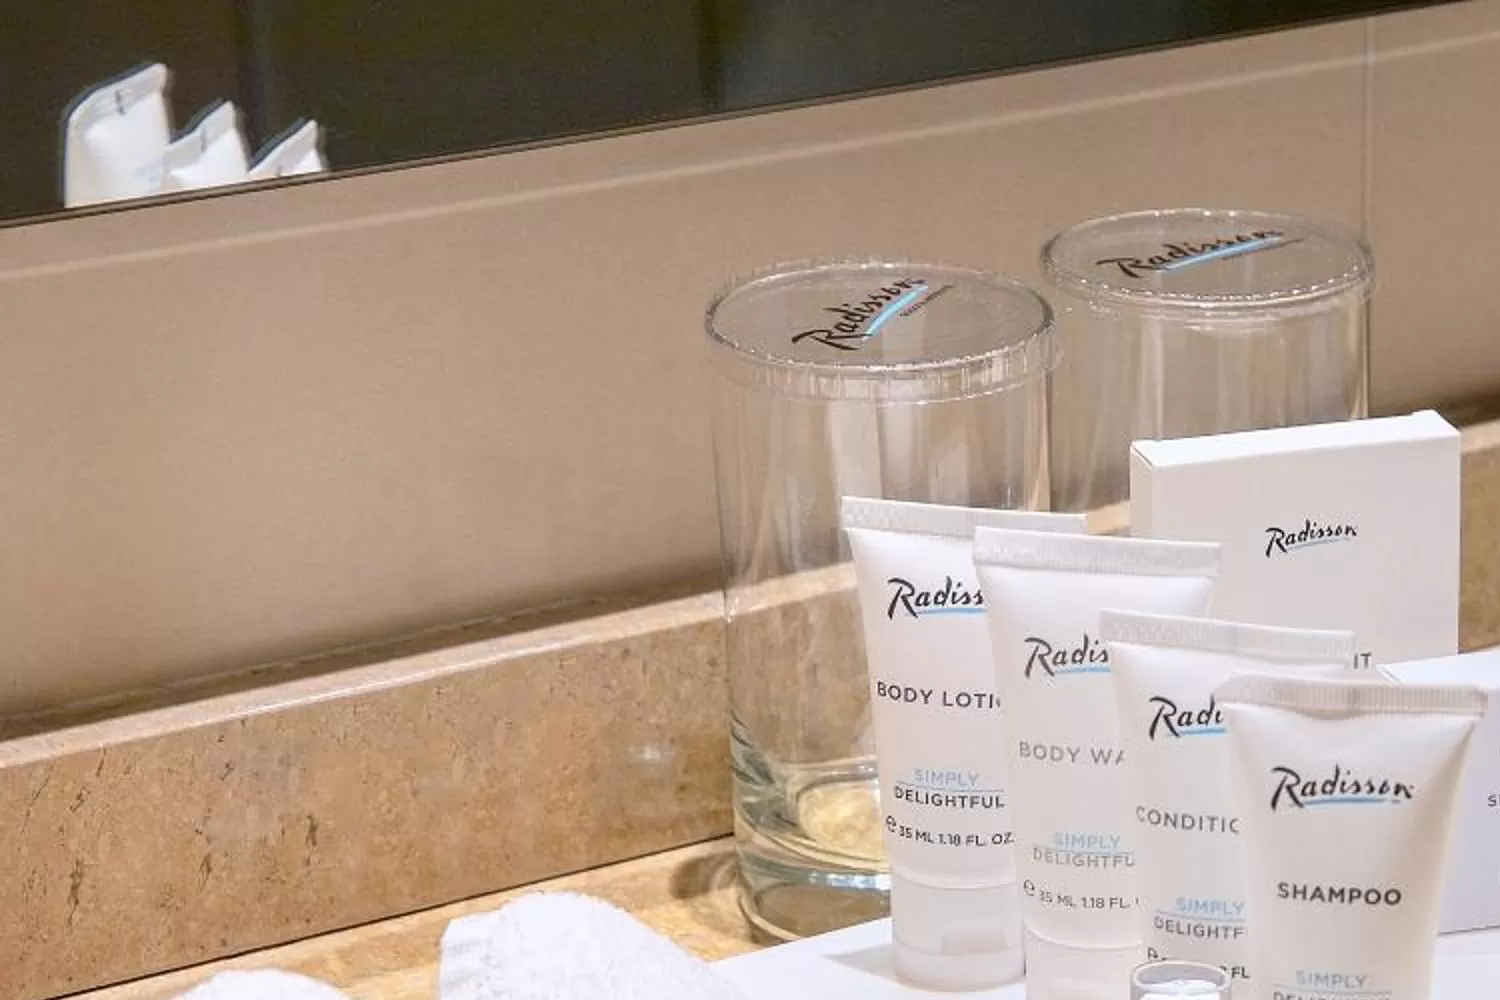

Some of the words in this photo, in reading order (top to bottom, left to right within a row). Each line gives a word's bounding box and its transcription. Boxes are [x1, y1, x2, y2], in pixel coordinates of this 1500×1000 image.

[1096, 231, 1284, 279] Radisson
[792, 278, 926, 350] Radisson
[1265, 519, 1358, 558] Radisson
[887, 576, 984, 620] Radiss
[1024, 633, 1109, 679] Radis
[877, 681, 933, 704] BODY
[1020, 741, 1080, 763] BODY
[915, 769, 980, 787] SIMPLY
[1270, 764, 1414, 811] Radisson
[894, 785, 1005, 809] DELIGHTFUL
[915, 829, 934, 844] ML
[1055, 832, 1120, 850] SIMPLY
[1277, 881, 1402, 906] SHAMPOO
[1176, 897, 1245, 915] SIMPLY
[1296, 970, 1368, 989] SIMPLY
